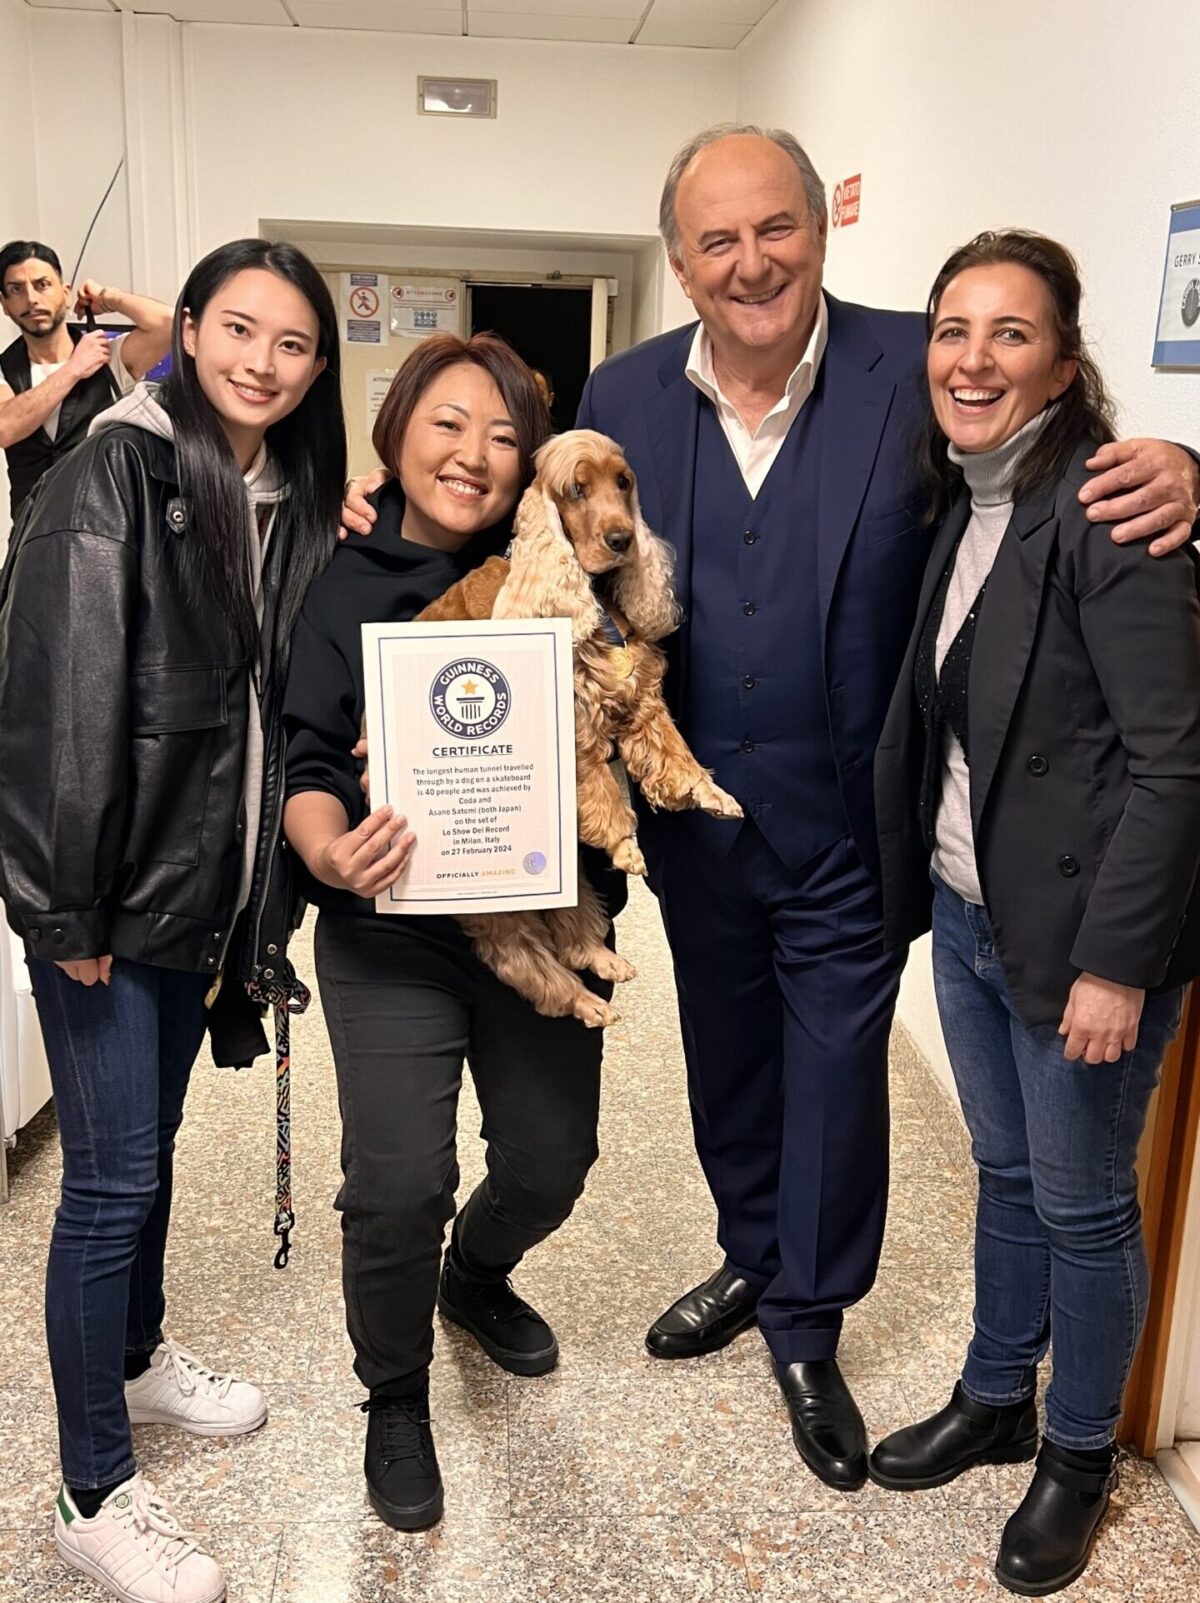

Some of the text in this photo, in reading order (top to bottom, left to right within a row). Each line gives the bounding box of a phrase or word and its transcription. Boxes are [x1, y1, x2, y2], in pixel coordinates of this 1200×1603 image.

[1174, 253, 1196, 267] GERRY
[440, 662, 500, 685] GUINNESS
[434, 692, 507, 735] WORLD RECORDS
[432, 744, 513, 757] CERTIFICATE
[426, 767, 452, 776] longest
[416, 777, 444, 786] through
[445, 776, 454, 785] by
[461, 776, 475, 785] dog
[492, 774, 531, 782] skateboard
[436, 787, 460, 796] people
[491, 784, 522, 793] achieved
[523, 784, 531, 792] by
[478, 806, 497, 814] (both
[498, 804, 522, 814] Japan)
[485, 825, 510, 834] Record
[485, 836, 500, 844] Italy
[462, 846, 492, 855] February
